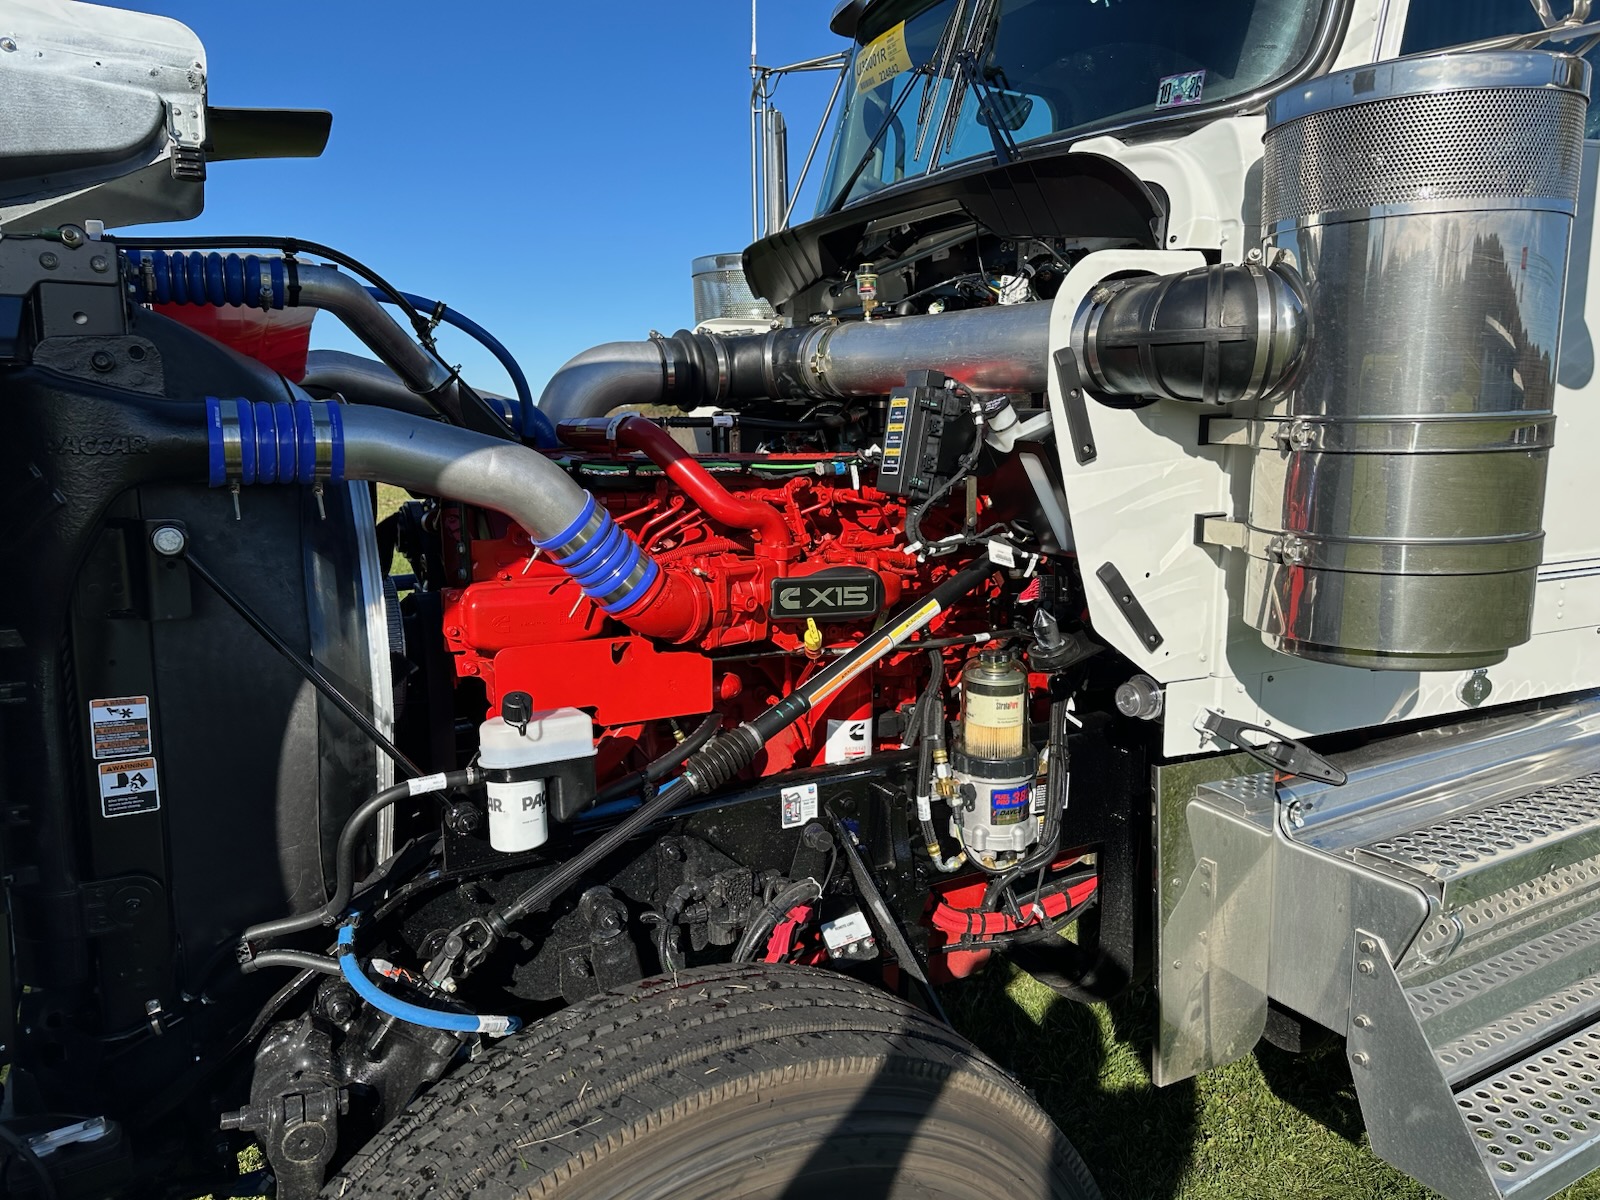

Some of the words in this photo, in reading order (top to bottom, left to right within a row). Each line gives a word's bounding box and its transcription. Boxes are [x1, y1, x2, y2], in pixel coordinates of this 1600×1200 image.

[1160, 82, 1172, 105] 10
[1189, 75, 1202, 98] 26
[47, 435, 149, 455] ACCAR
[806, 586, 869, 608] X15
[112, 761, 149, 771] WARNING
